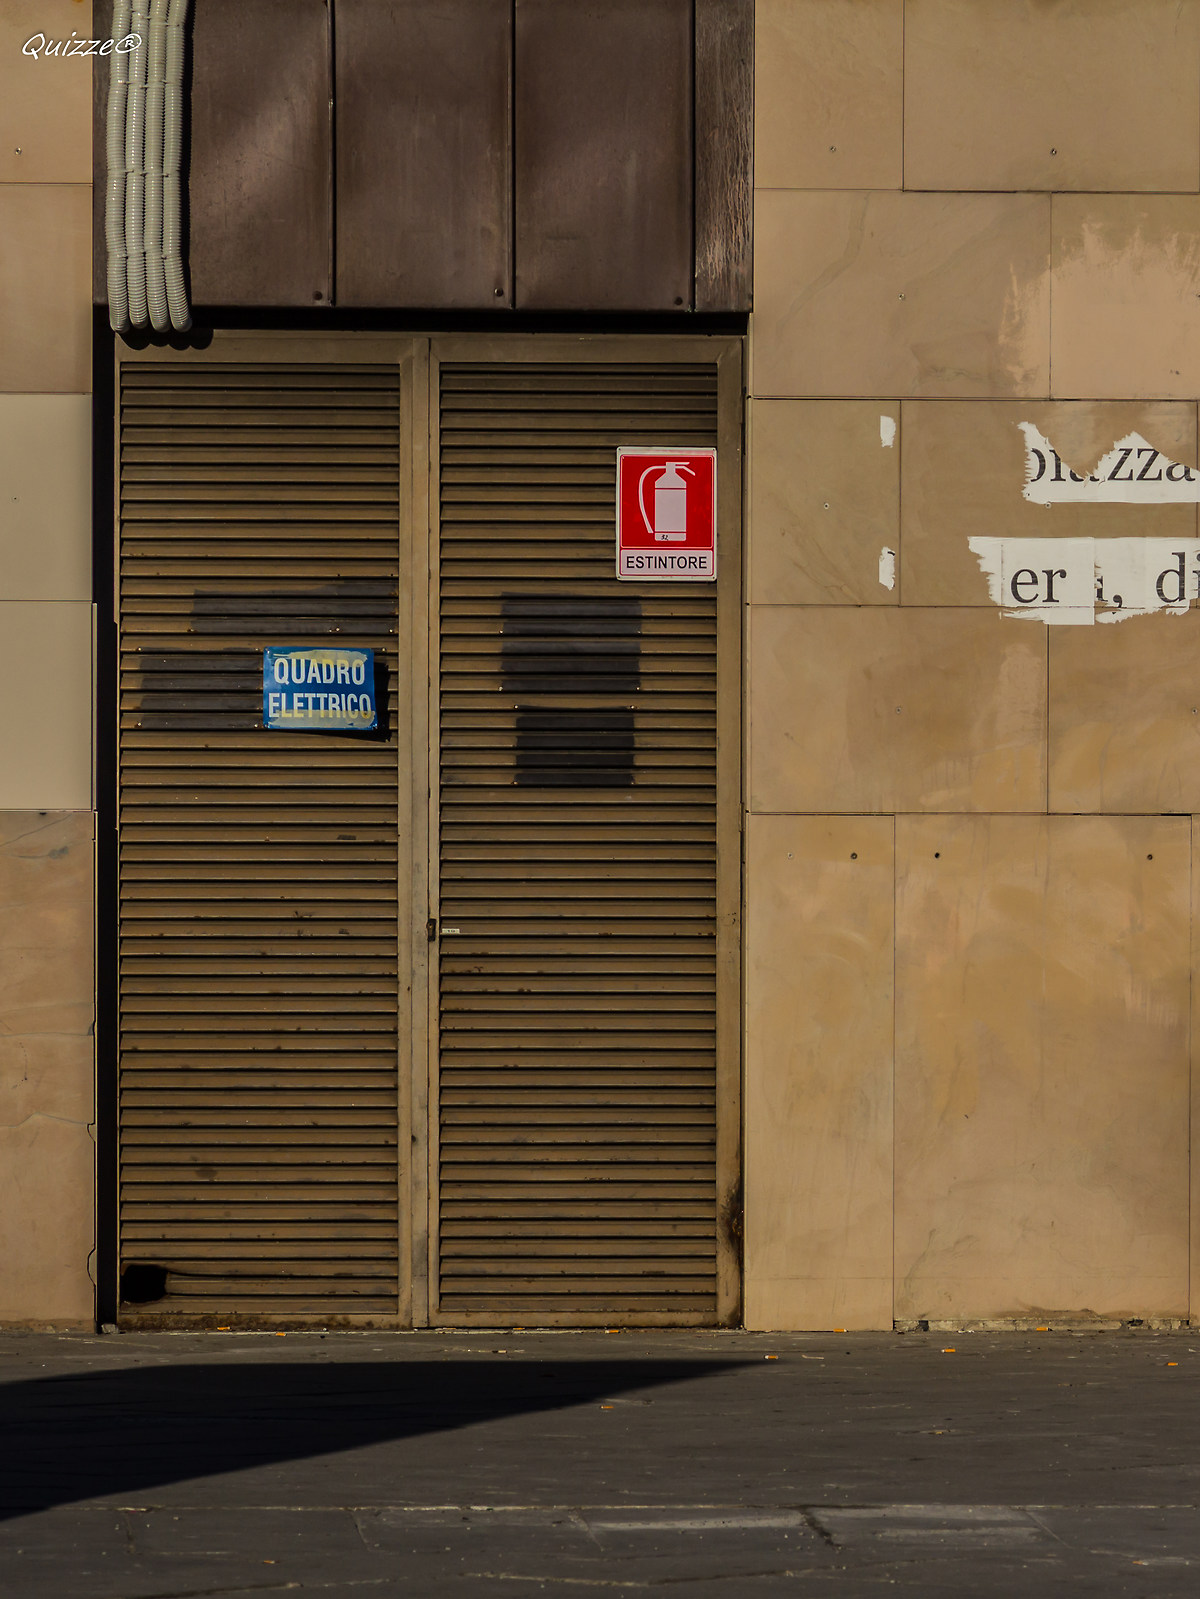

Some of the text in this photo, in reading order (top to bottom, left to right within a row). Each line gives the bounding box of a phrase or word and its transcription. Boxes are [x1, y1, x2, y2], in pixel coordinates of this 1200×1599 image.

[626, 555, 708, 569] ESTINTORE
[273, 657, 366, 686] QUADRO
[268, 692, 372, 719] ELETTRICO
